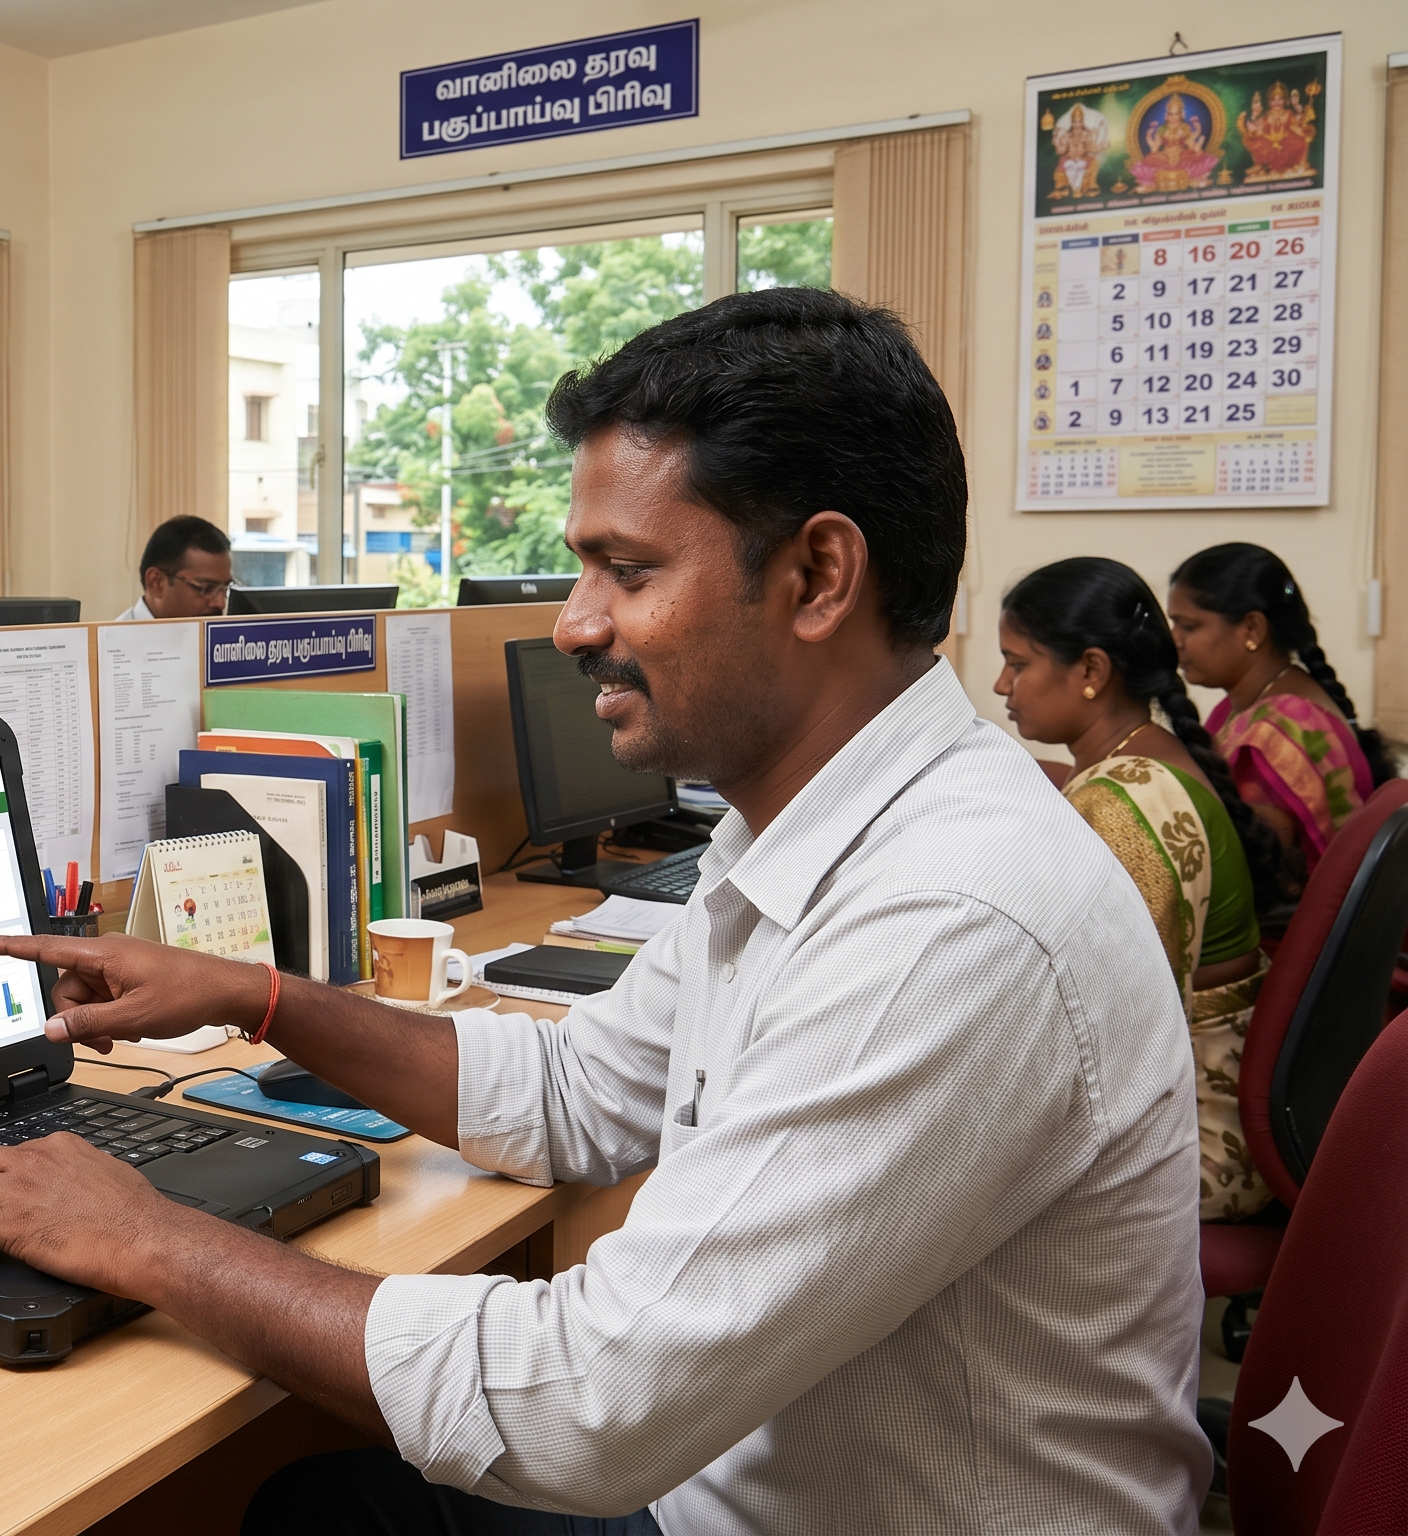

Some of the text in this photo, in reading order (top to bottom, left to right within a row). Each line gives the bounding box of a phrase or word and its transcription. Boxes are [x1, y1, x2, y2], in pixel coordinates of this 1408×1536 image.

[436, 44, 657, 101] வானிலை தரவு
[422, 80, 672, 142] பகுப்பாய்வு பிரிவு
[1154, 237, 1305, 266] 8 16 20 26
[1113, 270, 1304, 300] 2 9 17 21 27
[1111, 303, 1303, 332] 5 10 18 22 28
[1110, 335, 1302, 364] 6 11 19 23 29
[1070, 368, 1302, 397] 1 7 12 20 24 30
[1069, 403, 1256, 428] 2 9 13 21 25
